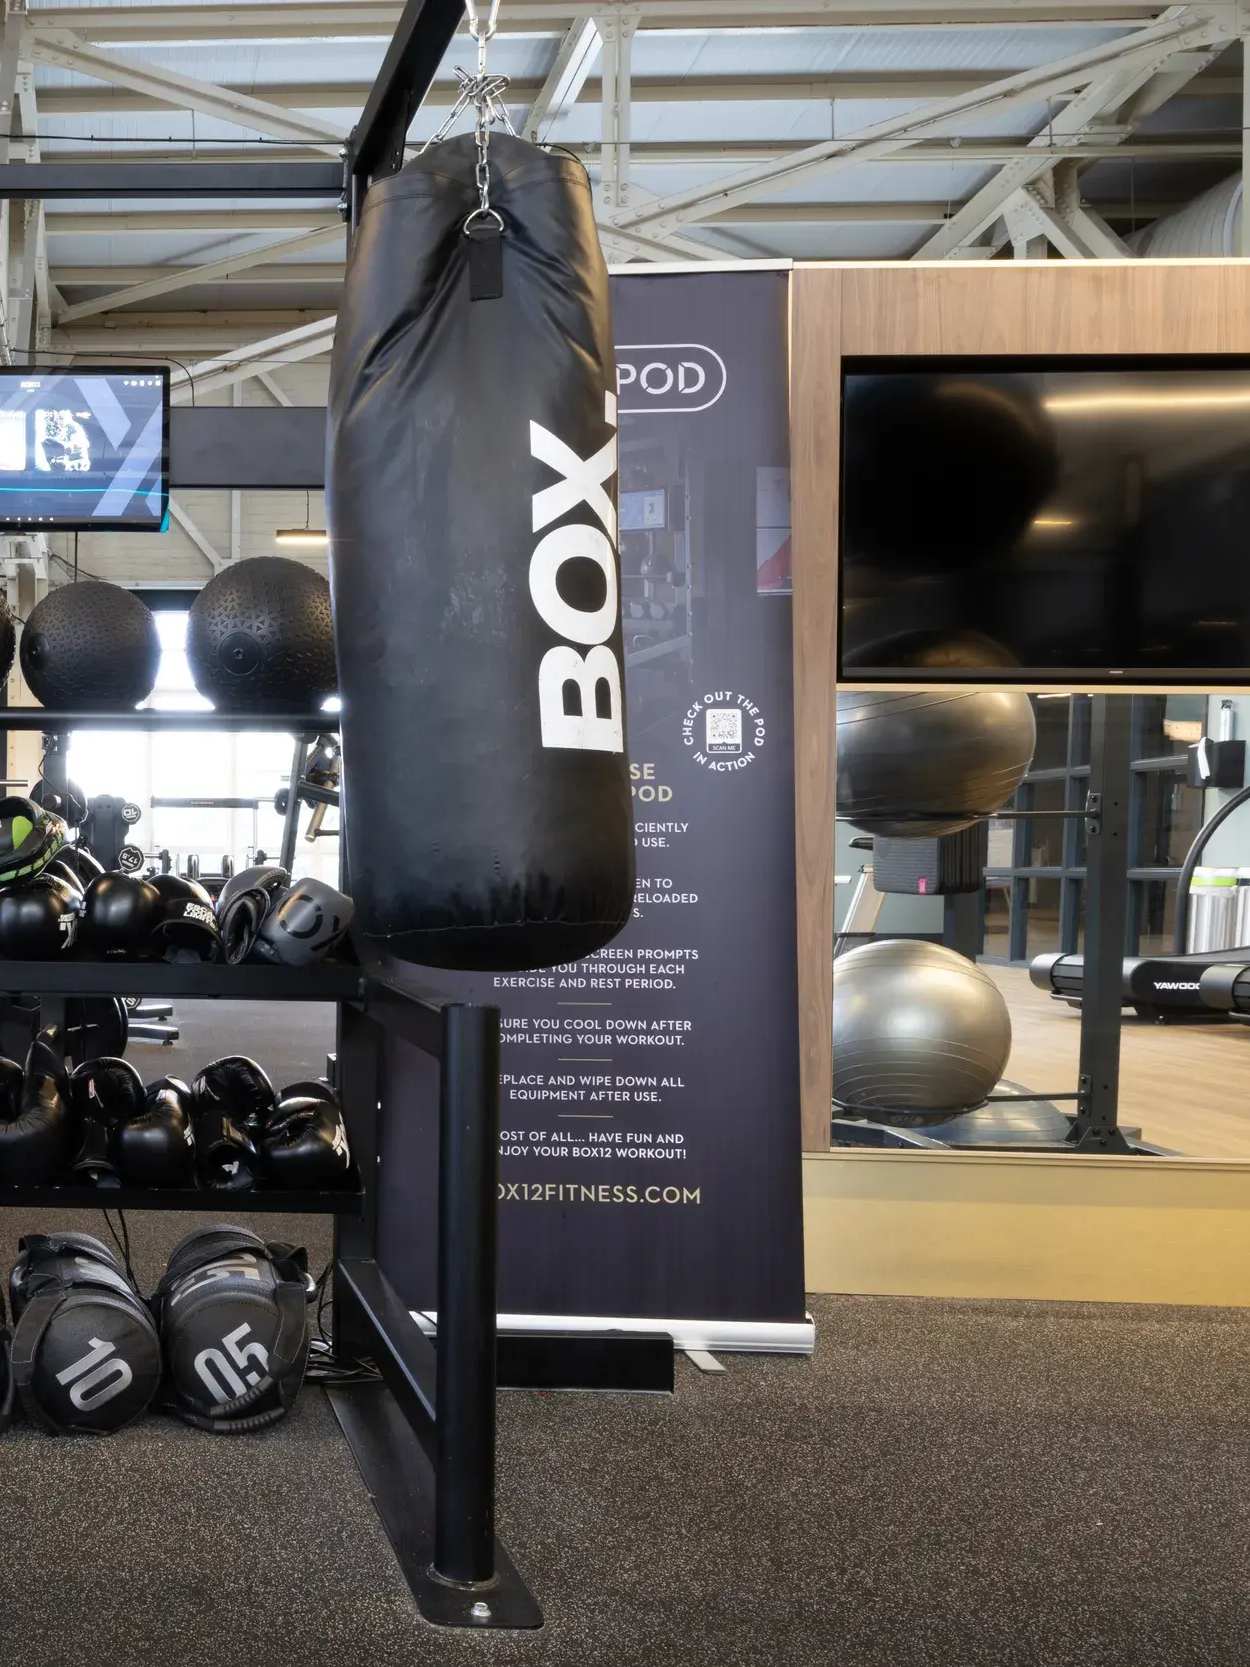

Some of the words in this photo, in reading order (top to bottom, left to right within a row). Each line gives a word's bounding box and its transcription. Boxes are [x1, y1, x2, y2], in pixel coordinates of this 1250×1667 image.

[616, 361, 706, 395] POD
[682, 701, 703, 746] CHECK
[704, 691, 732, 704] OUT
[736, 694, 760, 716] THE
[754, 718, 765, 746] POD
[693, 751, 708, 765] IN
[708, 752, 756, 772] ACTION
[629, 763, 656, 780] SE
[635, 822, 689, 833] CIENTLY
[642, 838, 670, 847] USE.
[655, 878, 673, 888] TO
[637, 949, 699, 960] PROMPTS
[551, 963, 577, 973] YOU
[581, 963, 646, 974] THROUGH
[650, 964, 685, 974] EACH
[494, 977, 555, 988] EXERCISE
[559, 978, 586, 988] AND
[590, 978, 621, 988] REST
[625, 978, 676, 989] PERIOD.
[532, 1019, 560, 1029] YOU
[564, 1019, 602, 1030] COOL
[606, 1020, 647, 1030] DOWN
[650, 1020, 692, 1031] AFTER
[499, 1033, 573, 1044] OMPLETING
[576, 1034, 612, 1045] YOUR
[616, 1035, 685, 1046] WORKOUT.
[548, 1075, 575, 1085] AND
[579, 1076, 612, 1086] WIPE
[615, 1076, 656, 1087] DOWN
[661, 1077, 685, 1088] ALL
[510, 1090, 586, 1101] EQUIPMENT
[589, 1091, 630, 1101] AFTER
[634, 1091, 662, 1102] USE.
[500, 1131, 525, 1141] OST
[529, 1131, 547, 1142] OF
[550, 1132, 585, 1142] ALL...
[589, 1132, 622, 1143] HAVE
[626, 1133, 652, 1143] FUN
[656, 1133, 684, 1144] AND
[533, 1146, 568, 1157] YOUR
[572, 1147, 612, 1157] BOX12
[616, 1148, 687, 1159] WORKOUT!
[194, 1322, 270, 1404] 05
[55, 1337, 133, 1412] 10
